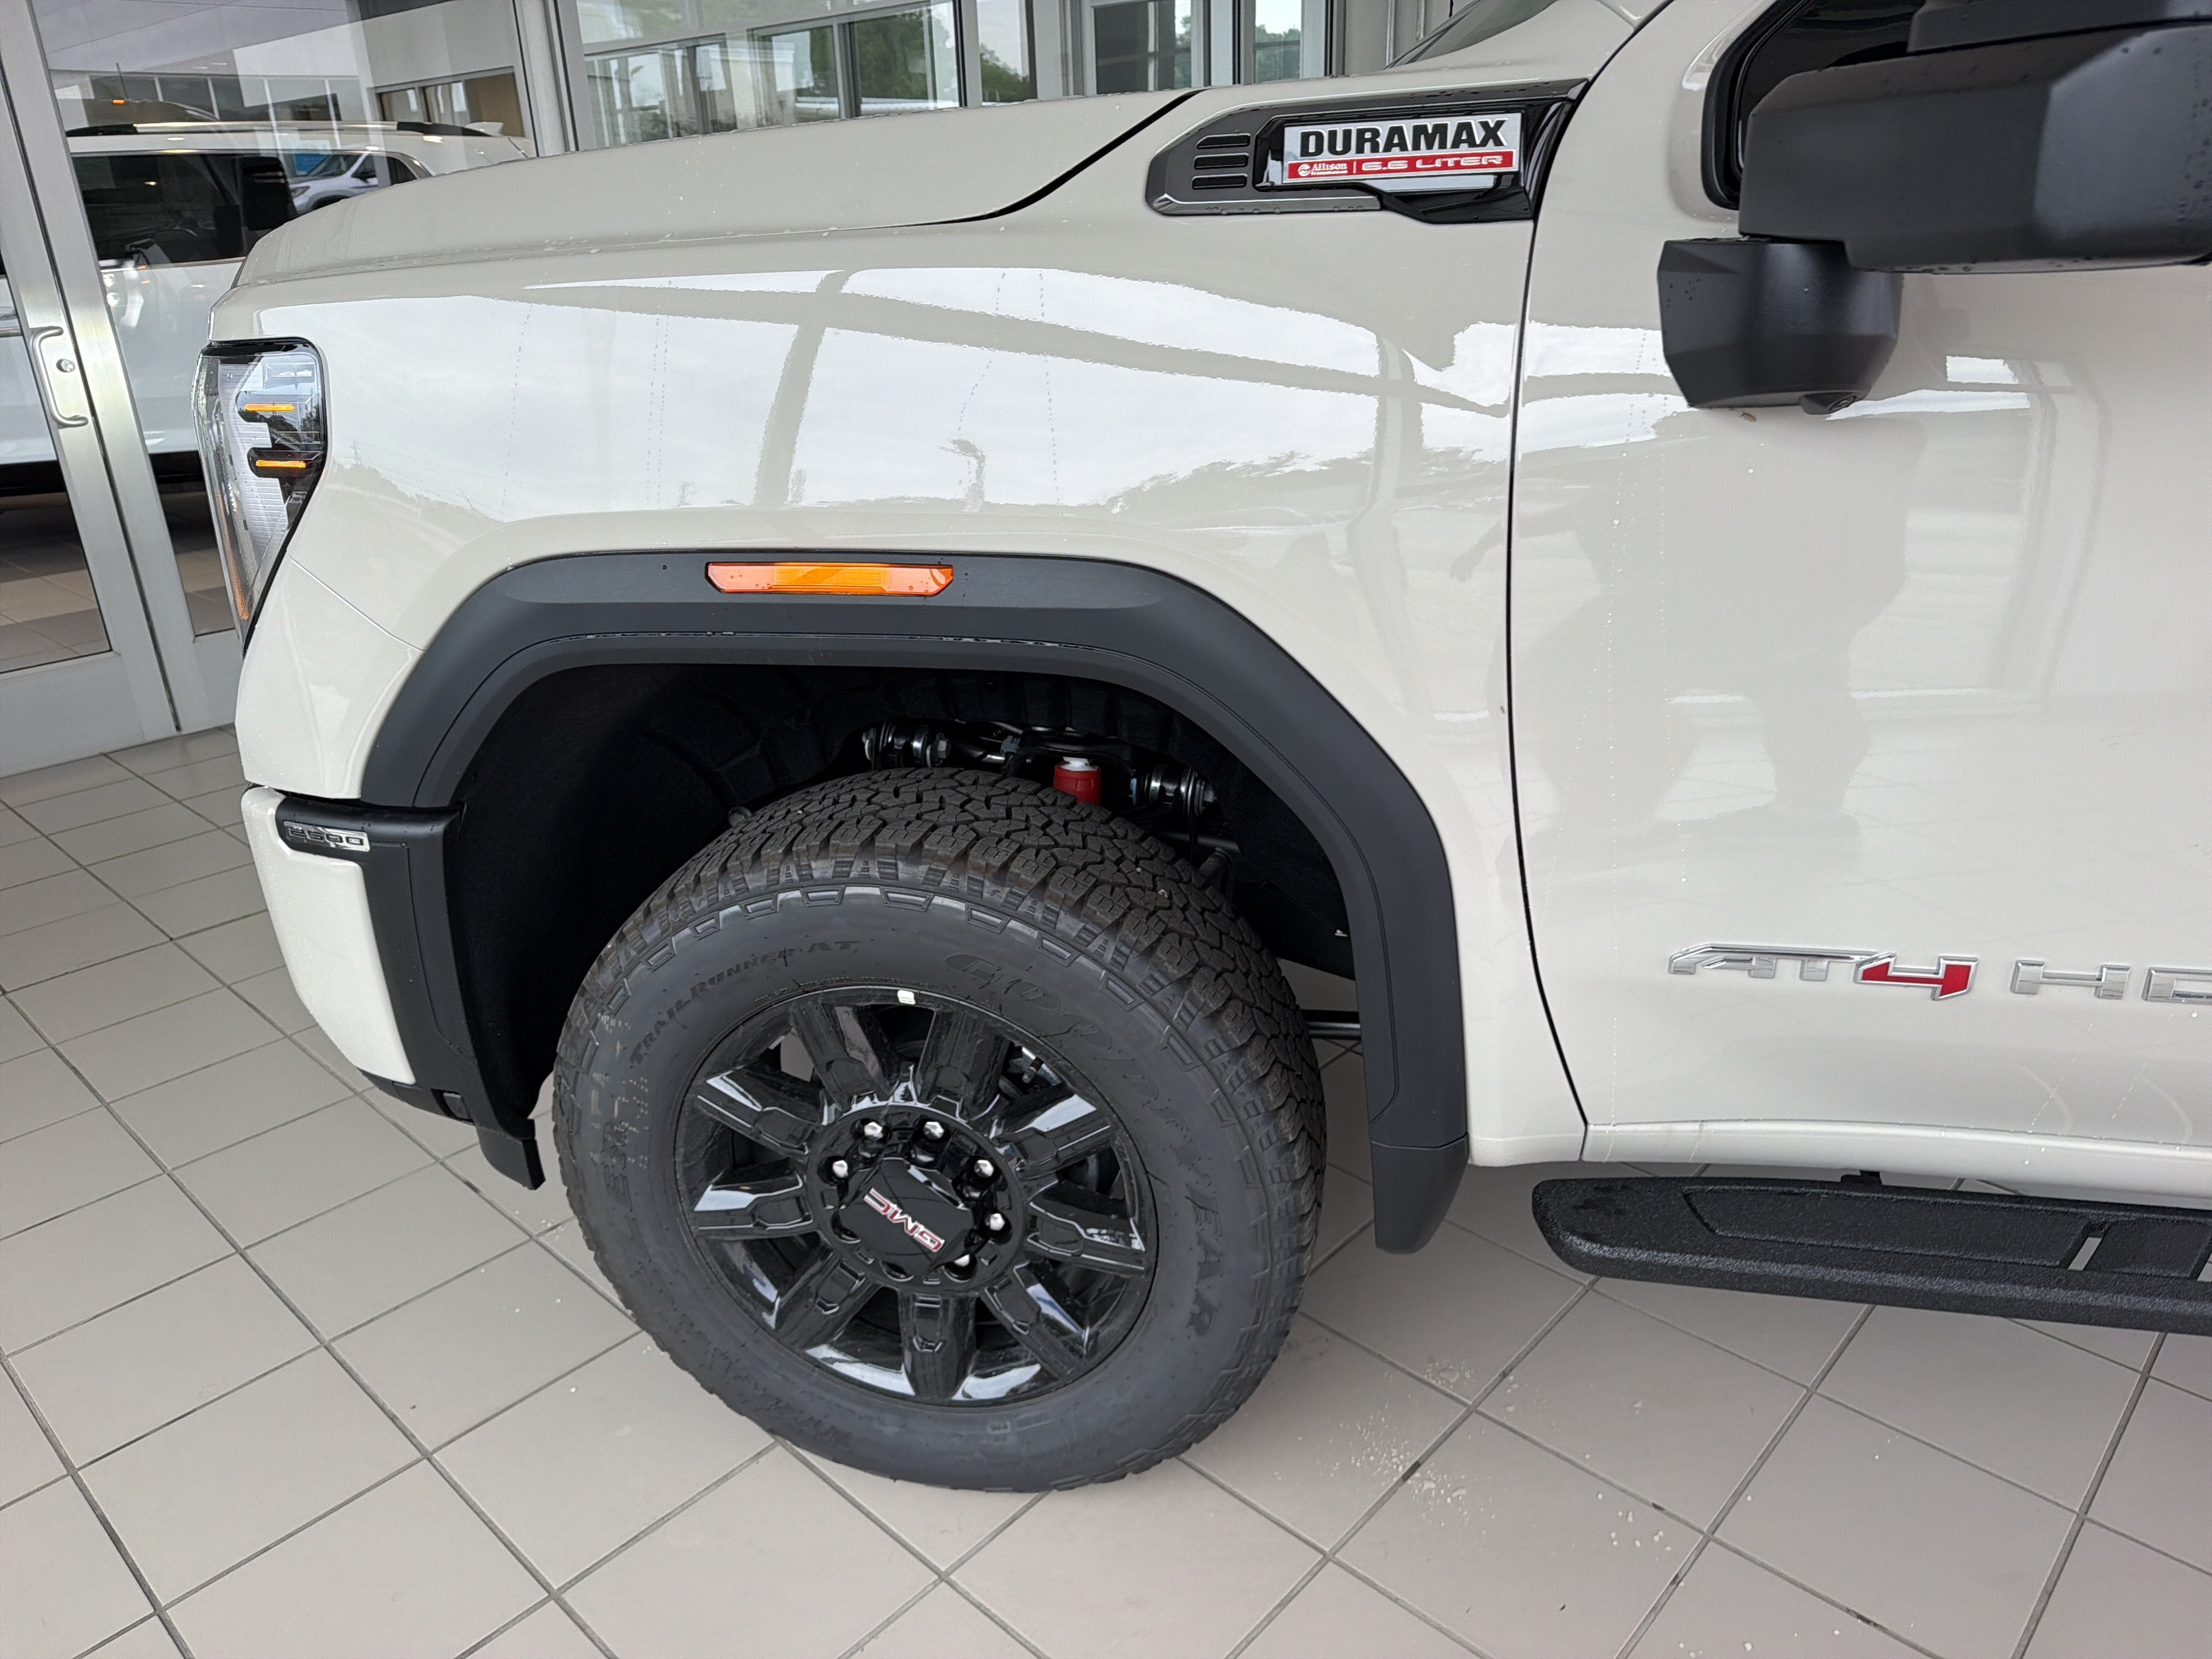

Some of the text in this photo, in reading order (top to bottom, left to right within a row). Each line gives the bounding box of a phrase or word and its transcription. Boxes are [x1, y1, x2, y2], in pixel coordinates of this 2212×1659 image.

[1300, 118, 1508, 158] DURAMAX
[1361, 155, 1504, 172] 6.6 LITER
[1668, 943, 1979, 1001] AT4
[864, 1188, 945, 1252] GMC
